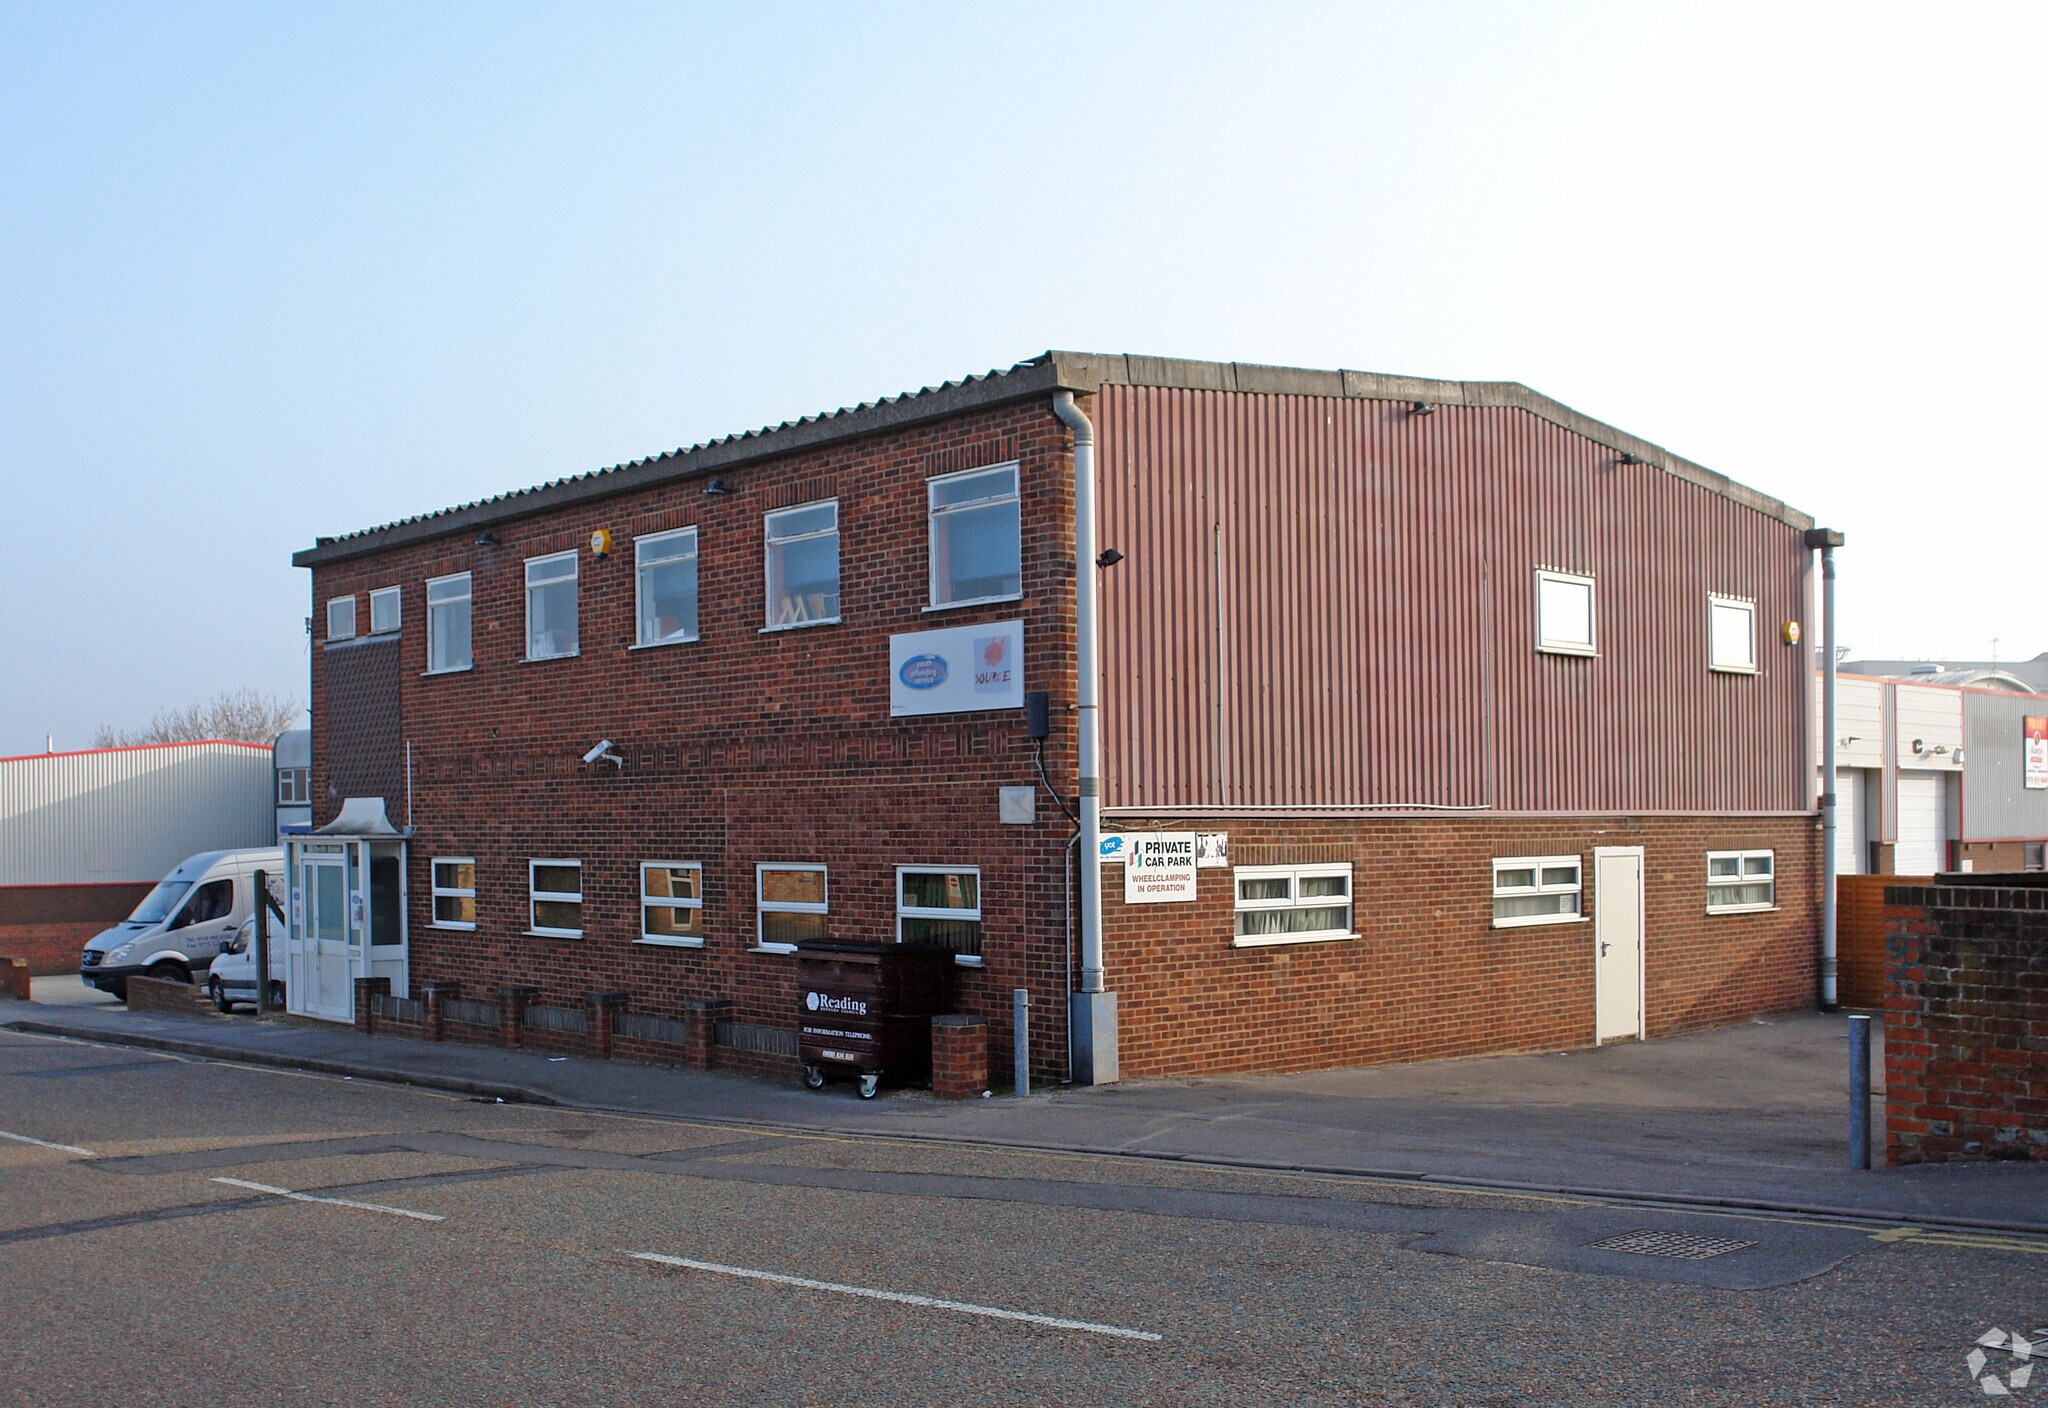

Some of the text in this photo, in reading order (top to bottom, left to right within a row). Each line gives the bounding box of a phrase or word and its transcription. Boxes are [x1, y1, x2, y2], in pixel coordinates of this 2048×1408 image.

[975, 670, 1011, 685] SOURCE
[1912, 738, 1923, 754] C
[1145, 841, 1192, 854] PRIVATE
[1145, 856, 1192, 867] CAR PARK
[1131, 873, 1191, 883] WHEELCLAMPING
[1137, 884, 1186, 893] IN OPERATION
[820, 993, 867, 1016] Reading
[813, 1027, 844, 1037] INFORMATION
